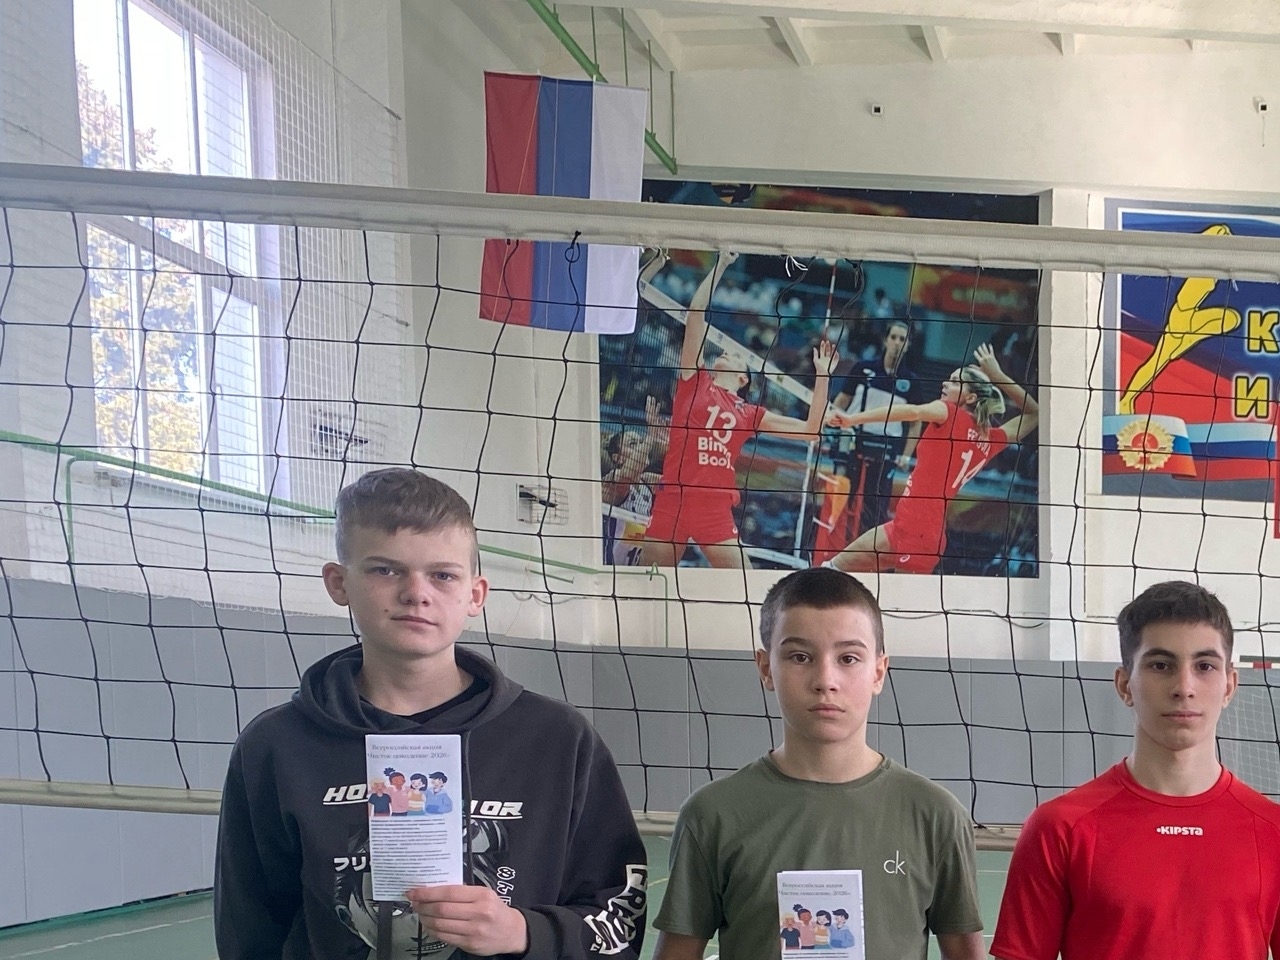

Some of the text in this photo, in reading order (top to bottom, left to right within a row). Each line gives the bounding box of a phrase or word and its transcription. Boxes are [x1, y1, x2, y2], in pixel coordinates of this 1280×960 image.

[1247, 311, 1279, 354] К
[1235, 376, 1270, 418] И
[706, 405, 737, 444] 13
[698, 436, 728, 455] Bin
[323, 783, 368, 802] HO
[333, 856, 371, 872] フリ
[883, 850, 906, 875] ck
